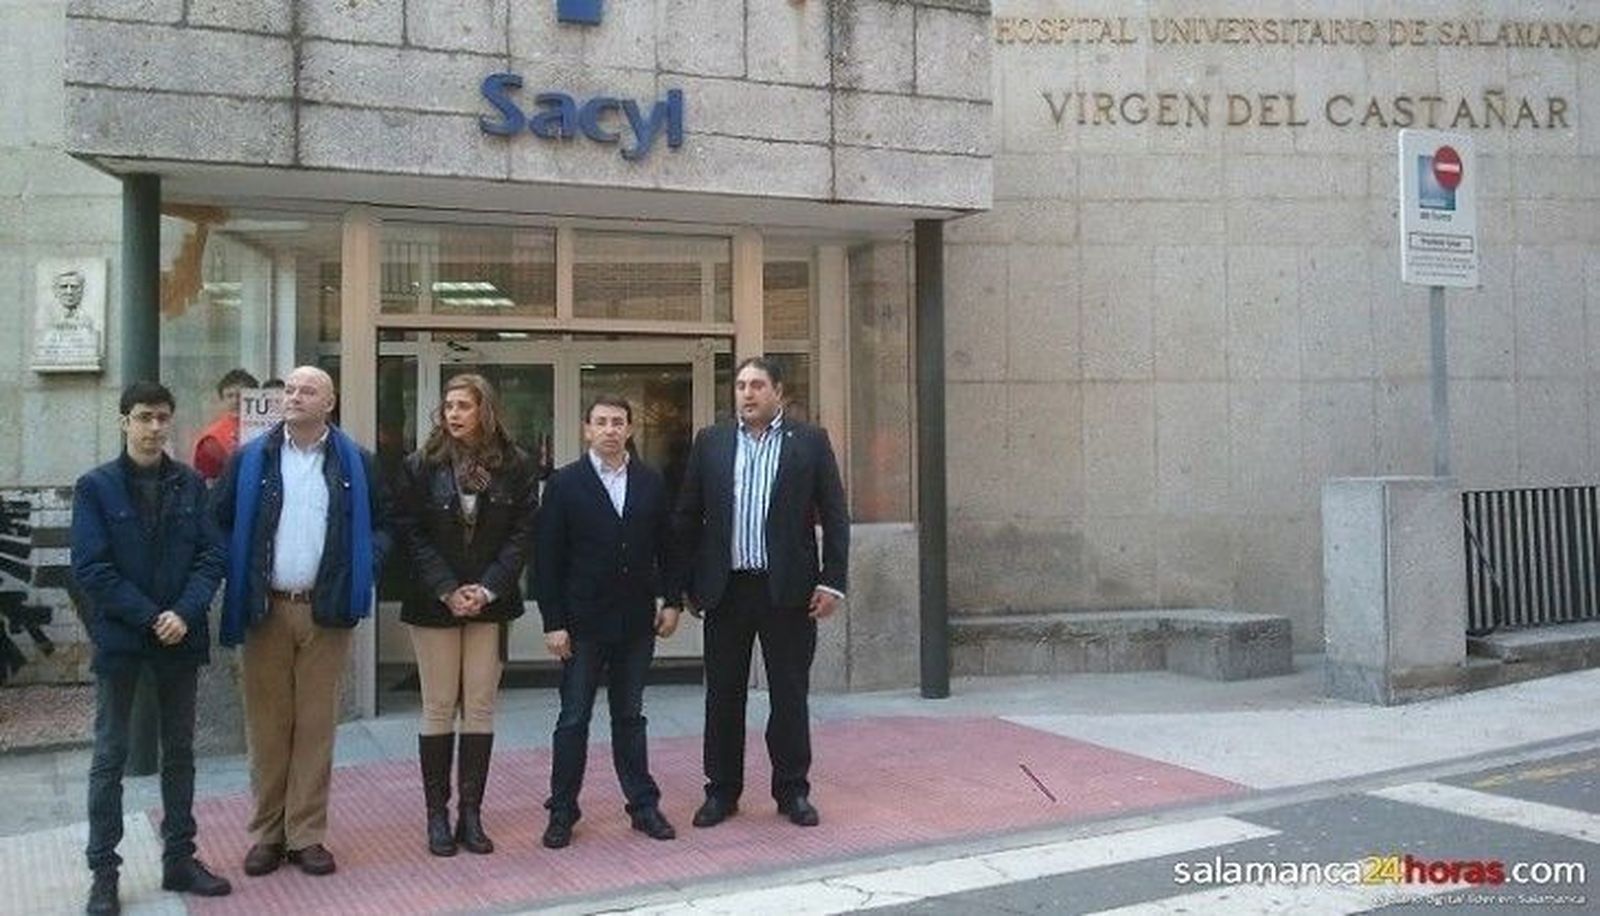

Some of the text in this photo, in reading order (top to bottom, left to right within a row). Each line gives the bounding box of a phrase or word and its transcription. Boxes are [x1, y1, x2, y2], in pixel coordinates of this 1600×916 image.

[994, 16, 1139, 45] HOSPITAL
[1150, 17, 1377, 47] UNIVERSITARIO
[1389, 20, 1428, 47] DE
[479, 73, 684, 161] Sacyl
[1042, 89, 1570, 129] VIRGEN DEL CASTAÑAR
[244, 393, 269, 415] TÚ
